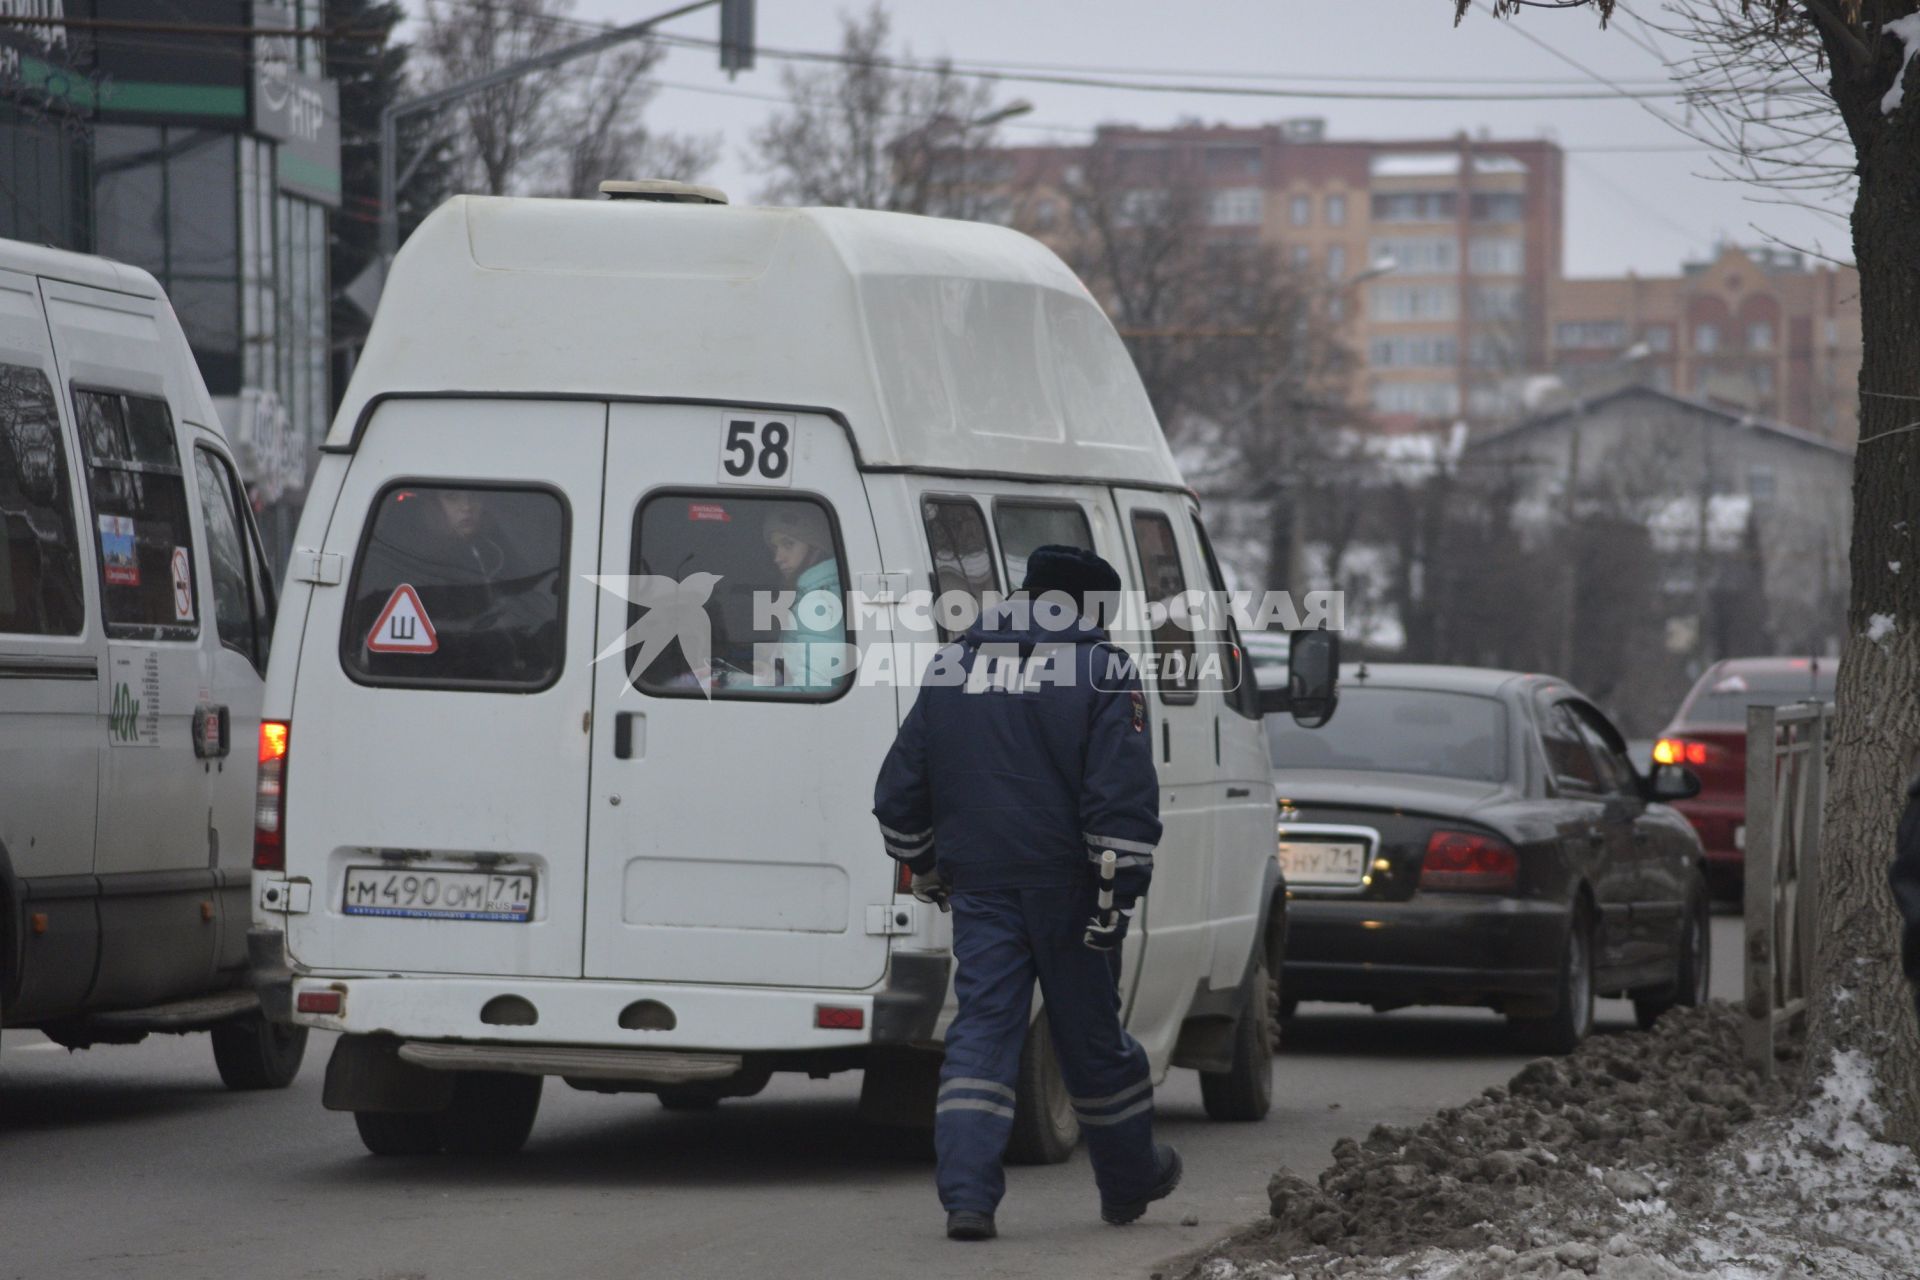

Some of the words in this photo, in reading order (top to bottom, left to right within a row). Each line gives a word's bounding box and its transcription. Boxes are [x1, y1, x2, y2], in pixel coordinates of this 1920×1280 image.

[723, 420, 789, 479] 58
[390, 616, 415, 640] Ш
[491, 877, 523, 901] 71
